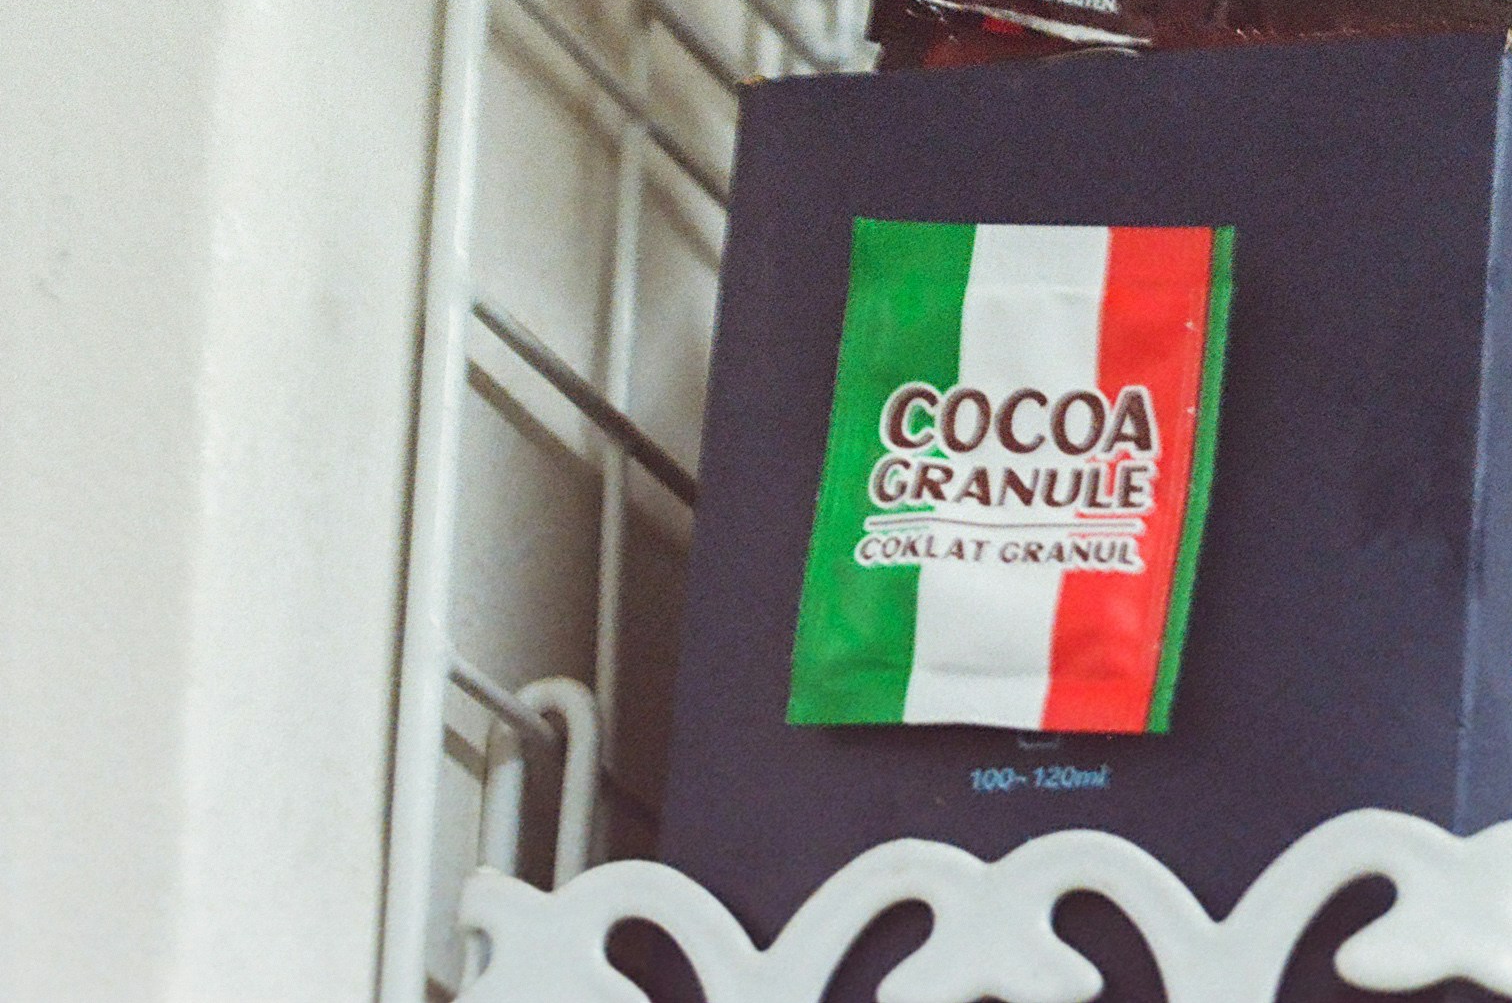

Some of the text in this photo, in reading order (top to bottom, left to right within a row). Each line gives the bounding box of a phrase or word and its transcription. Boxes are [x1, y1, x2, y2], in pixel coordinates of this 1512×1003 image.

[882, 385, 1156, 457] COCOA
[872, 455, 1153, 511] GRANULE
[858, 533, 1138, 568] COKLAT GRANUL
